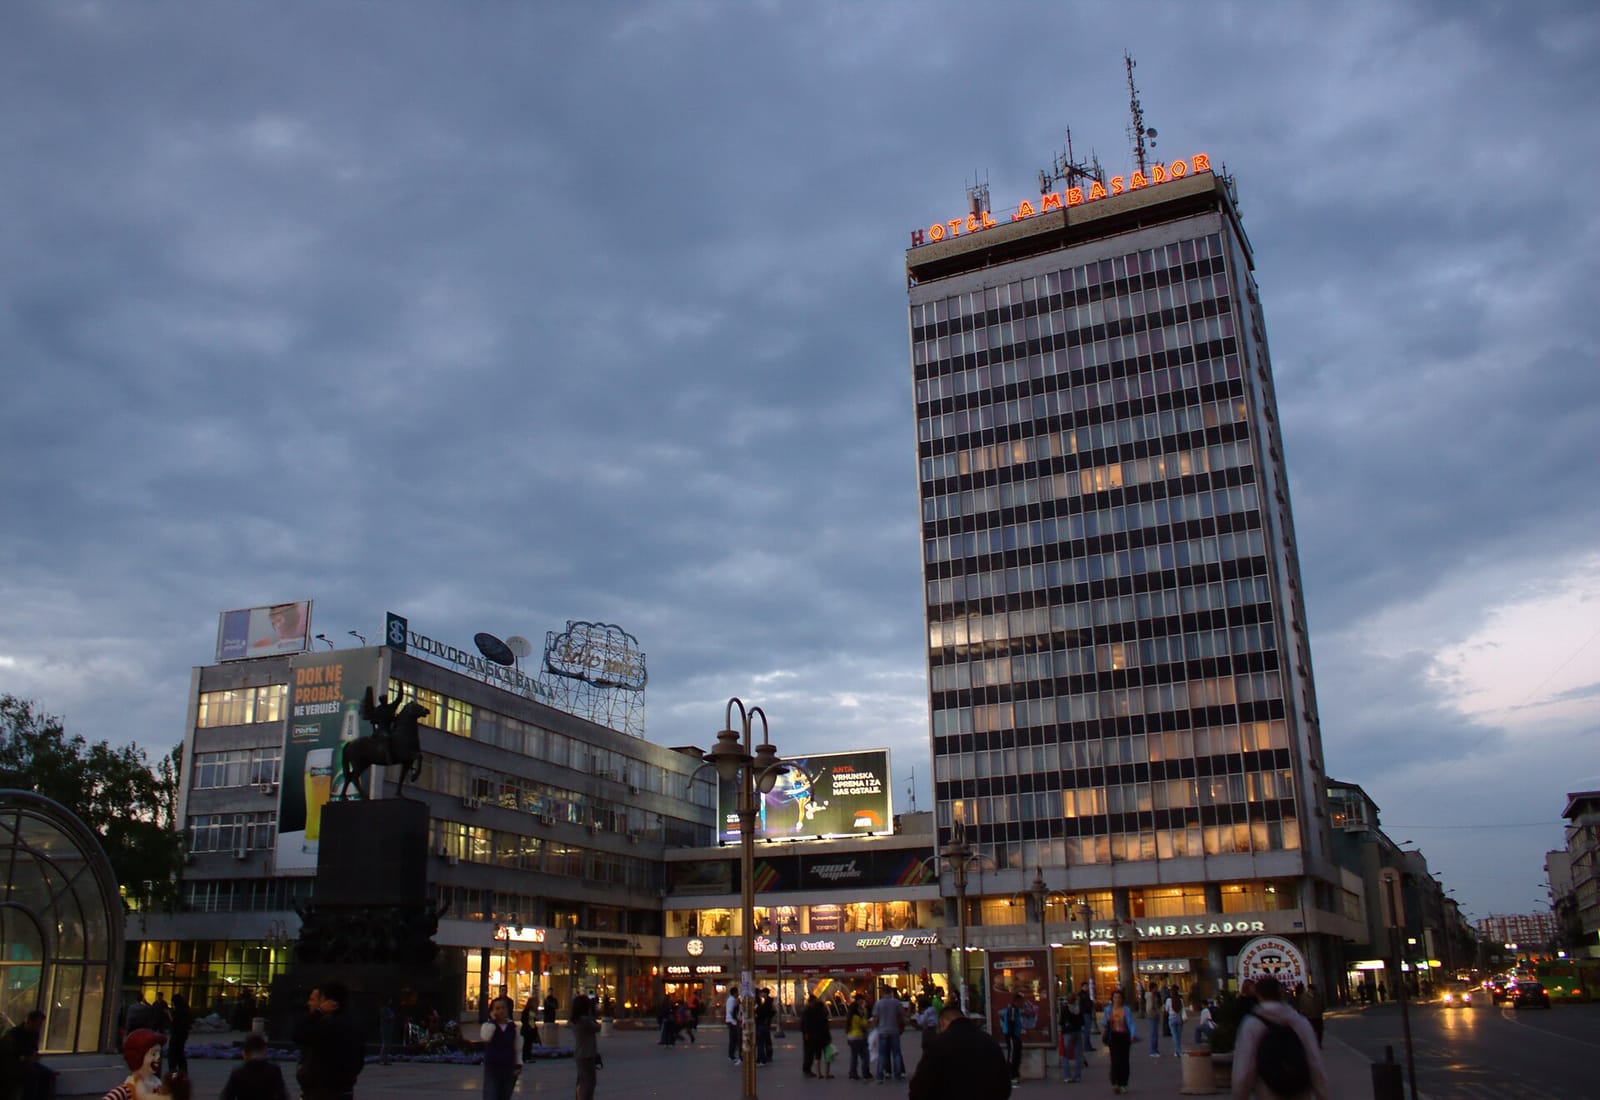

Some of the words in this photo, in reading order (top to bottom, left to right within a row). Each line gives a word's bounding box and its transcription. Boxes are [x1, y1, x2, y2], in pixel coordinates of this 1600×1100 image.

[911, 210, 997, 248] HOTEL
[1016, 152, 1211, 219] AMBASADOR
[296, 666, 323, 686] DOK
[325, 664, 343, 683] NE
[295, 682, 345, 703] PROBAŠ,
[516, 671, 555, 700] BANKA
[294, 705, 305, 717] NE
[306, 701, 341, 716] VERUJEŠ!
[832, 772, 875, 781] VRHUNSKA
[832, 780, 865, 789] OPREMA
[865, 779, 869, 787] I
[869, 779, 882, 787] ZA
[832, 788, 850, 797] NAS
[1136, 920, 1266, 939] AMBASADOR
[800, 940, 836, 951] Outlet
[667, 966, 690, 974] COSTA
[696, 965, 722, 974] COFFEE
